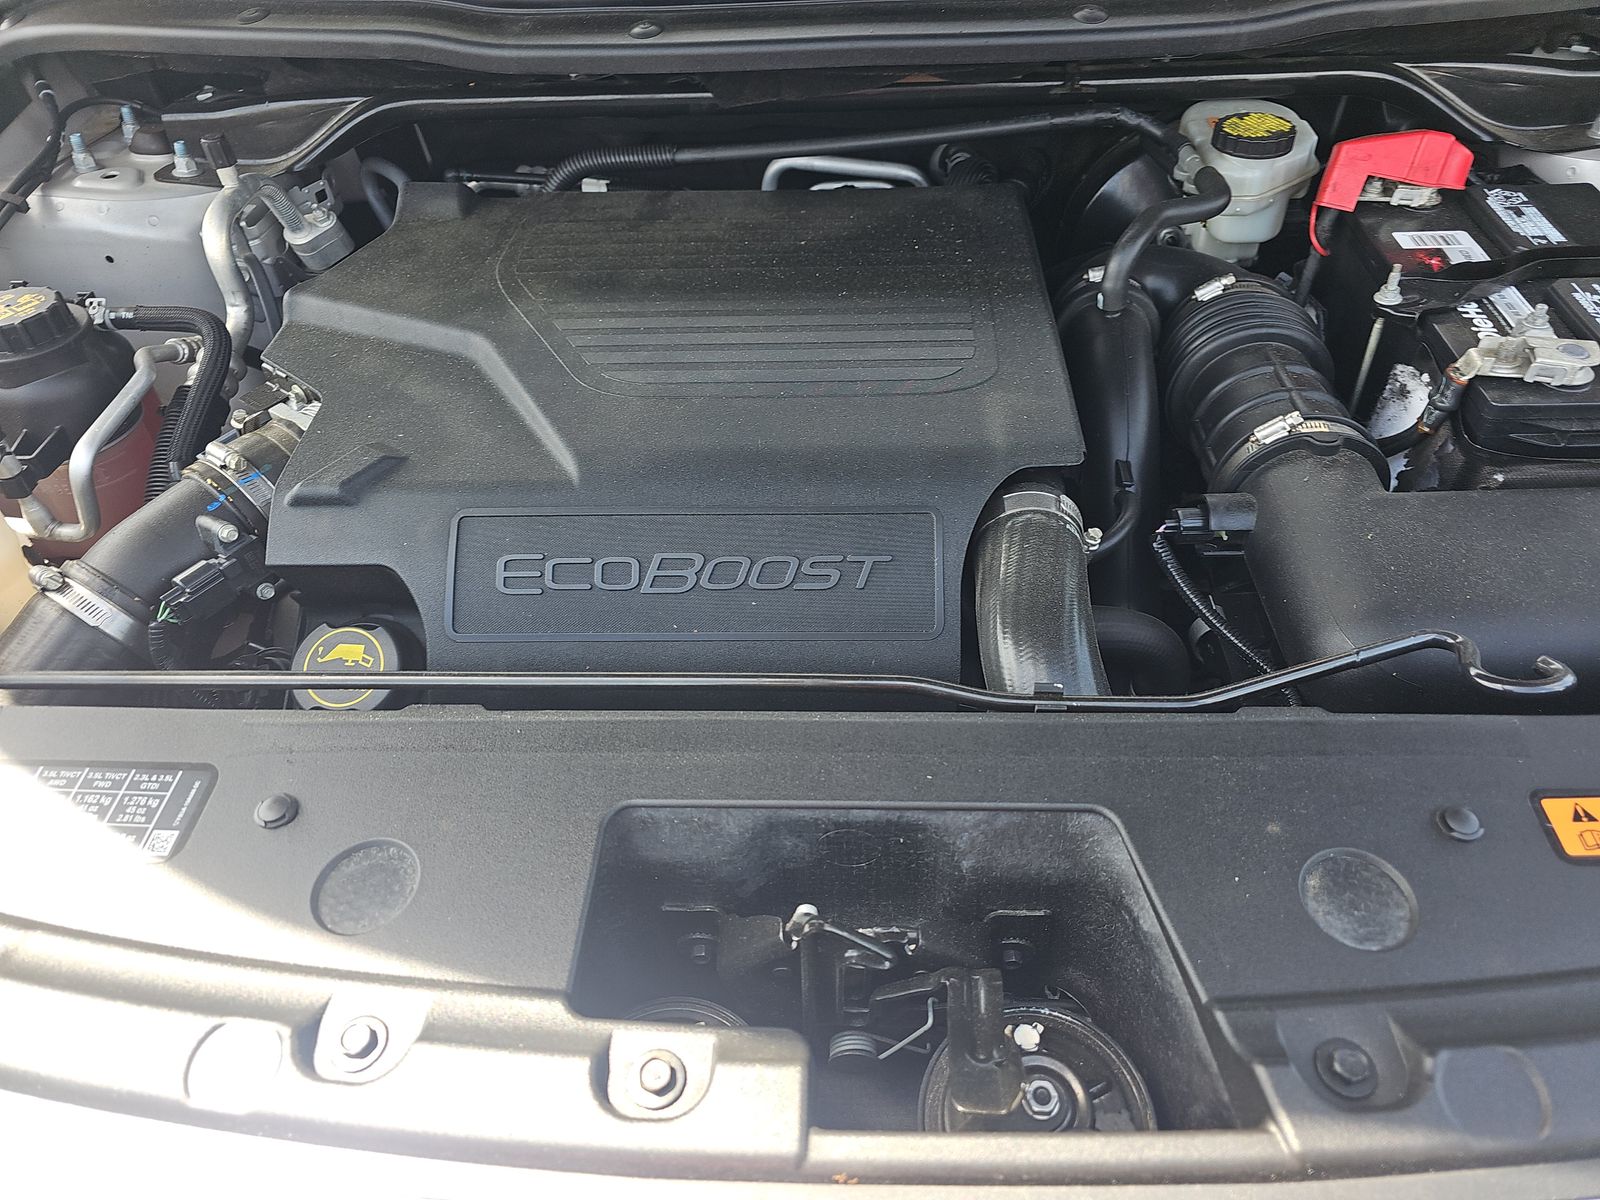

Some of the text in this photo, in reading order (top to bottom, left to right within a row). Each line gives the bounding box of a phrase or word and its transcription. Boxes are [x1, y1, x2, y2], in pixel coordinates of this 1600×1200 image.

[1456, 301, 1502, 341] DieHa
[92, 780, 112, 788] FWD
[99, 794, 112, 806] kg
[147, 796, 160, 808] kg
